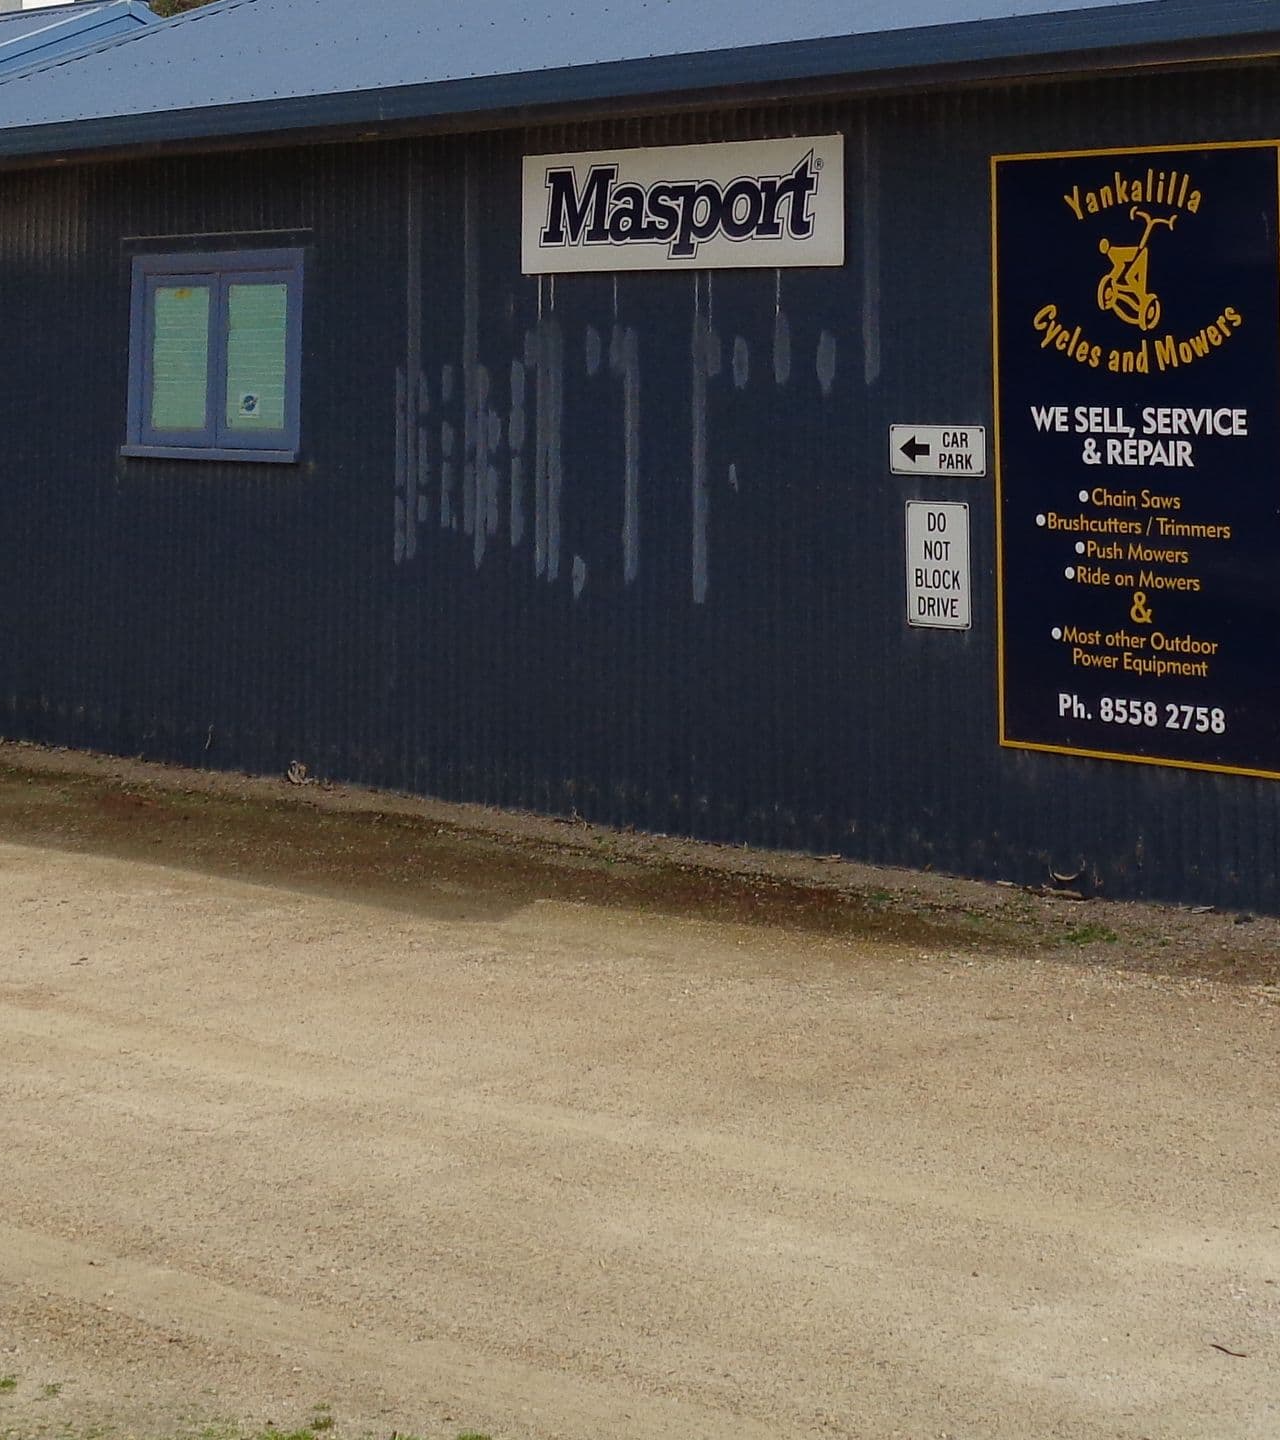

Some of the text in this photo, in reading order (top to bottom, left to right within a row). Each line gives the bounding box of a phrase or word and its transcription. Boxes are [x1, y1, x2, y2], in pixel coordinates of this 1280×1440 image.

[539, 148, 819, 260] Masport
[1064, 168, 1202, 220] Yankalilla
[1033, 304, 1242, 373] Cycles and Mowers
[1030, 406, 1248, 438] WE SELL, SERVICE
[942, 432, 970, 449] CAR
[1082, 438, 1195, 467] & REPAIR
[938, 453, 974, 470] PARK
[1091, 488, 1181, 510] Chain Saws
[927, 512, 947, 533] DO
[1047, 512, 1232, 539] Brushcutters / Trimmers
[923, 540, 951, 561] NOT
[1086, 540, 1190, 564] Push Mowers
[915, 568, 961, 590] BLOCK
[1077, 566, 1201, 591] Ride on Mowers
[918, 596, 959, 618] DRIVE
[1130, 591, 1153, 623] &
[1062, 625, 1218, 655] Most other Outdoor
[1072, 648, 1209, 677] Power Equipment
[1058, 693, 1226, 734] Ph. 8558 2758
